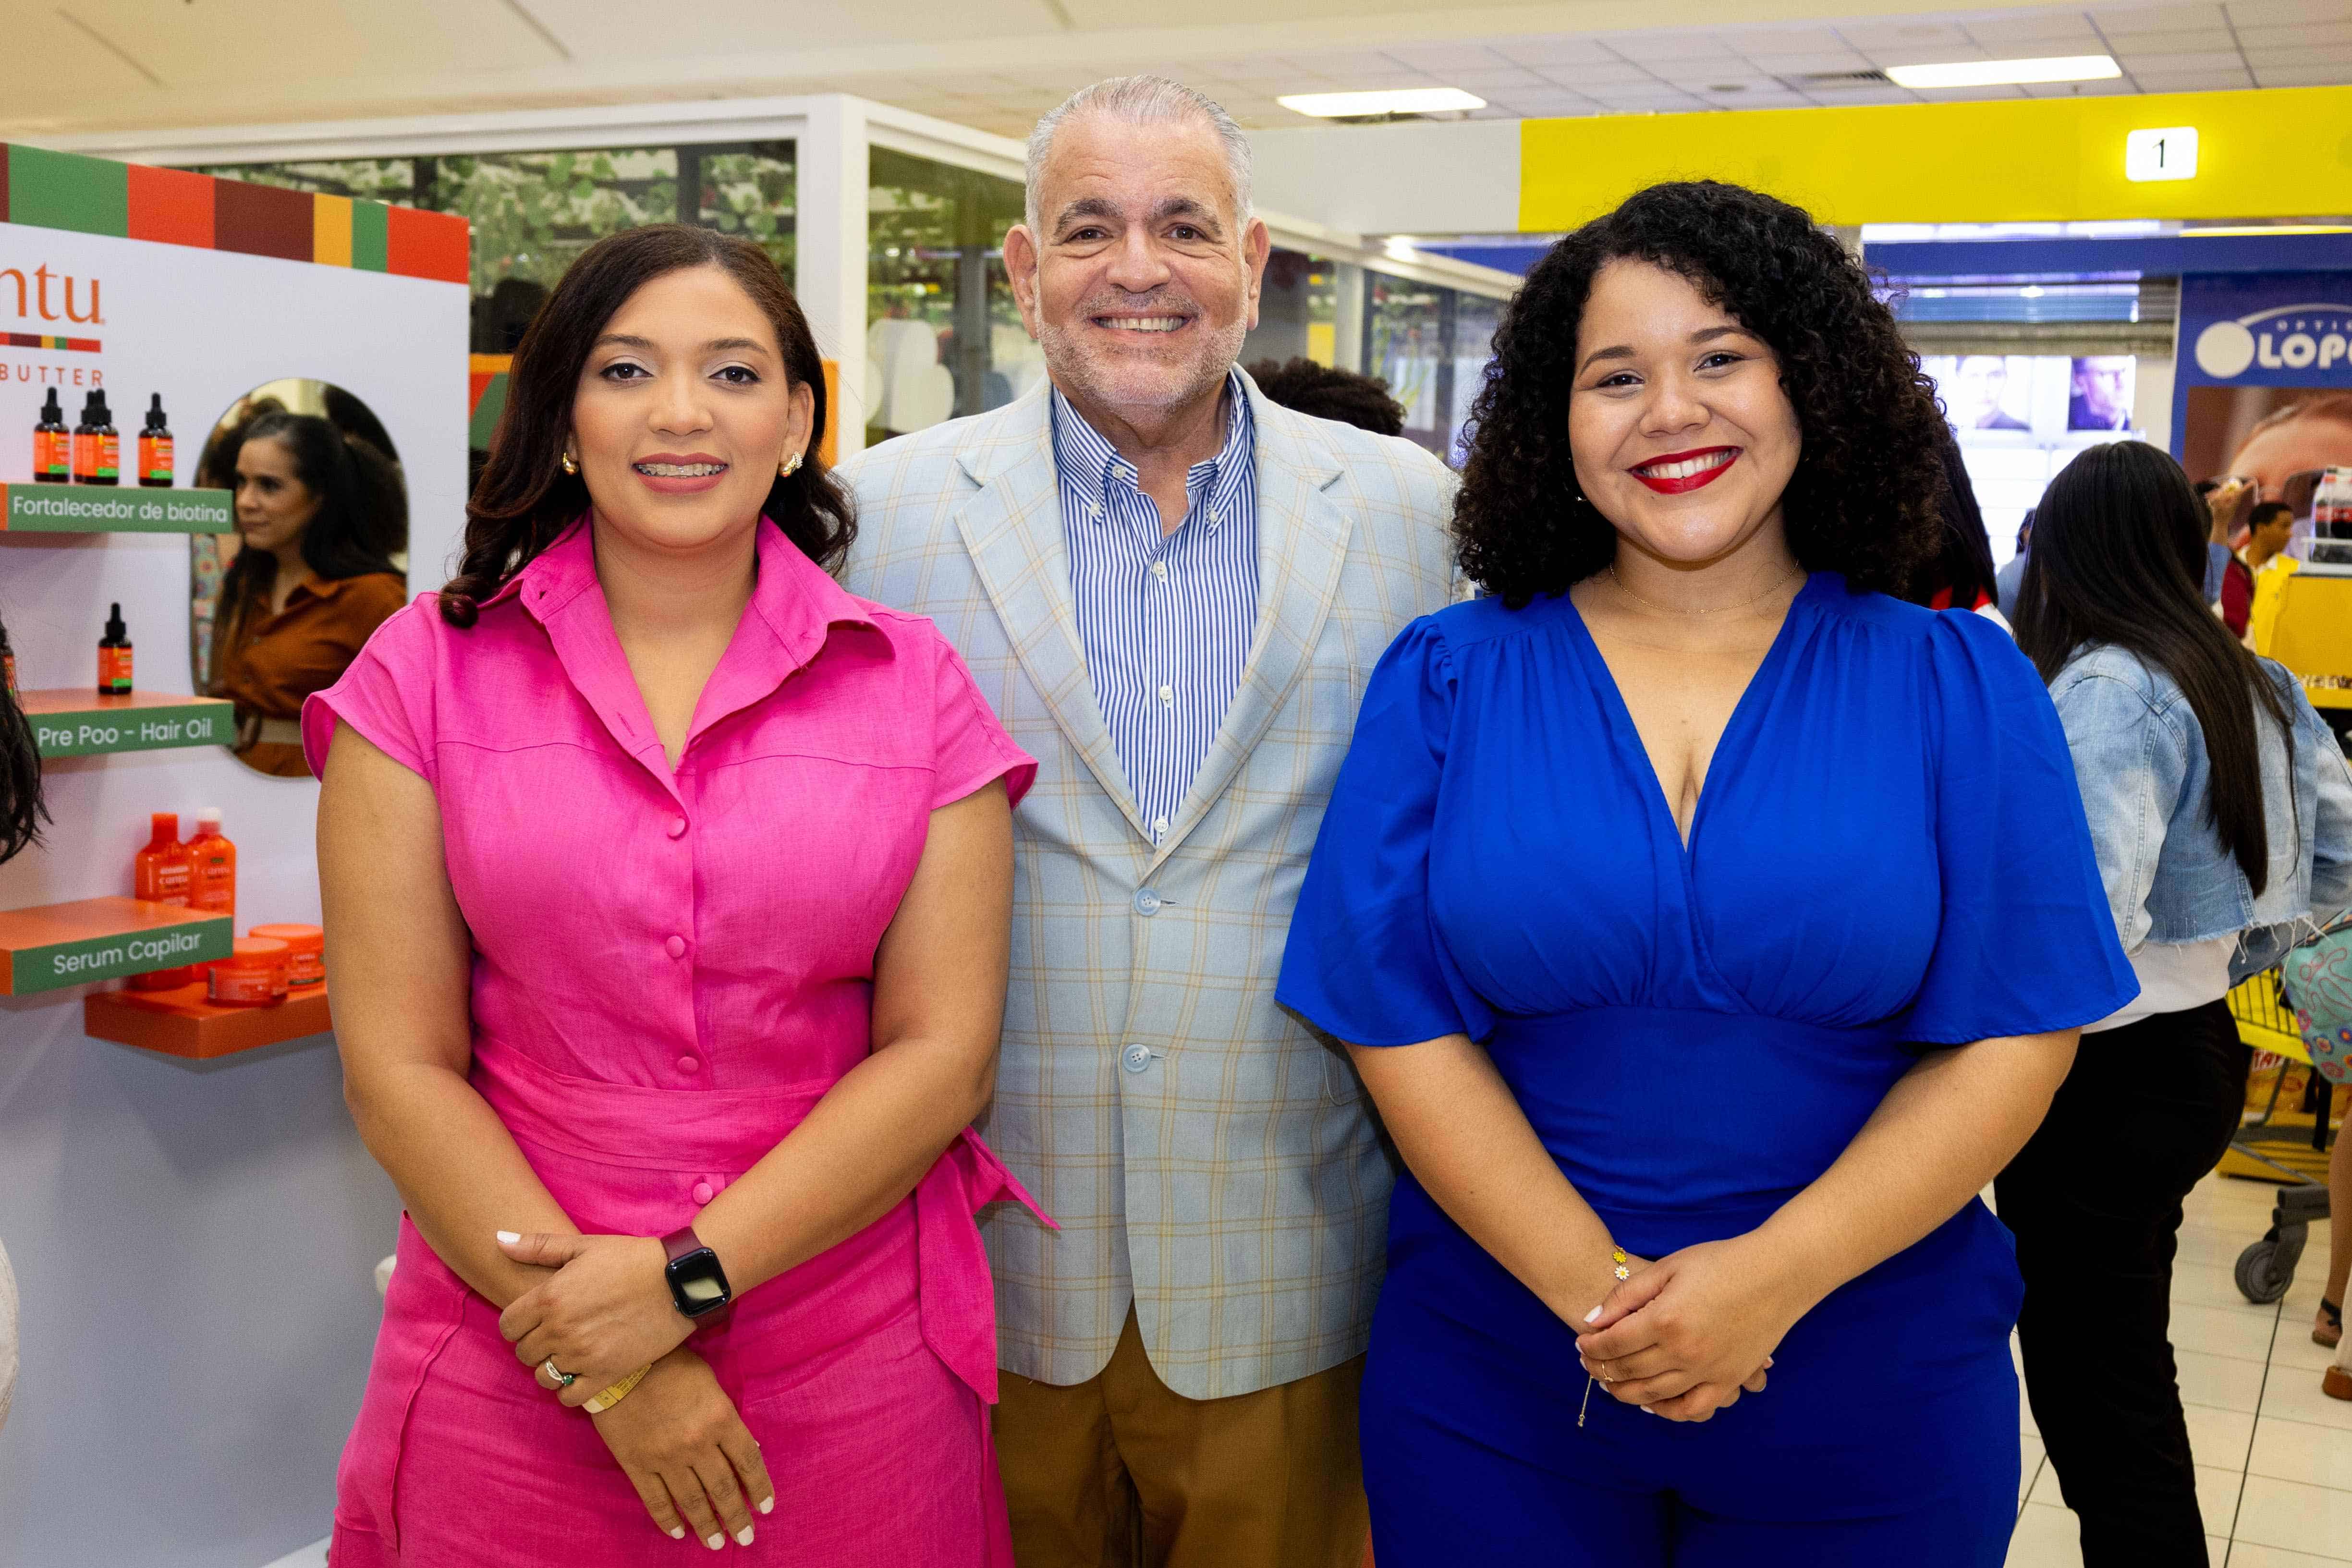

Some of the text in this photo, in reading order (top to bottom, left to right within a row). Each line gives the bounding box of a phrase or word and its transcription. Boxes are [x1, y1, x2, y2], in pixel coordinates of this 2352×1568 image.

[2152, 138, 2164, 168] 1
[2258, 333, 2352, 369] LOP
[0, 363, 103, 386] BUTTER
[13, 496, 228, 523] Fortalecedor de biotina
[38, 727, 73, 747] Pre
[79, 725, 119, 745] Poo
[141, 720, 181, 741] Hair
[186, 717, 212, 739] Oil
[53, 933, 201, 975] Serum Capilar
